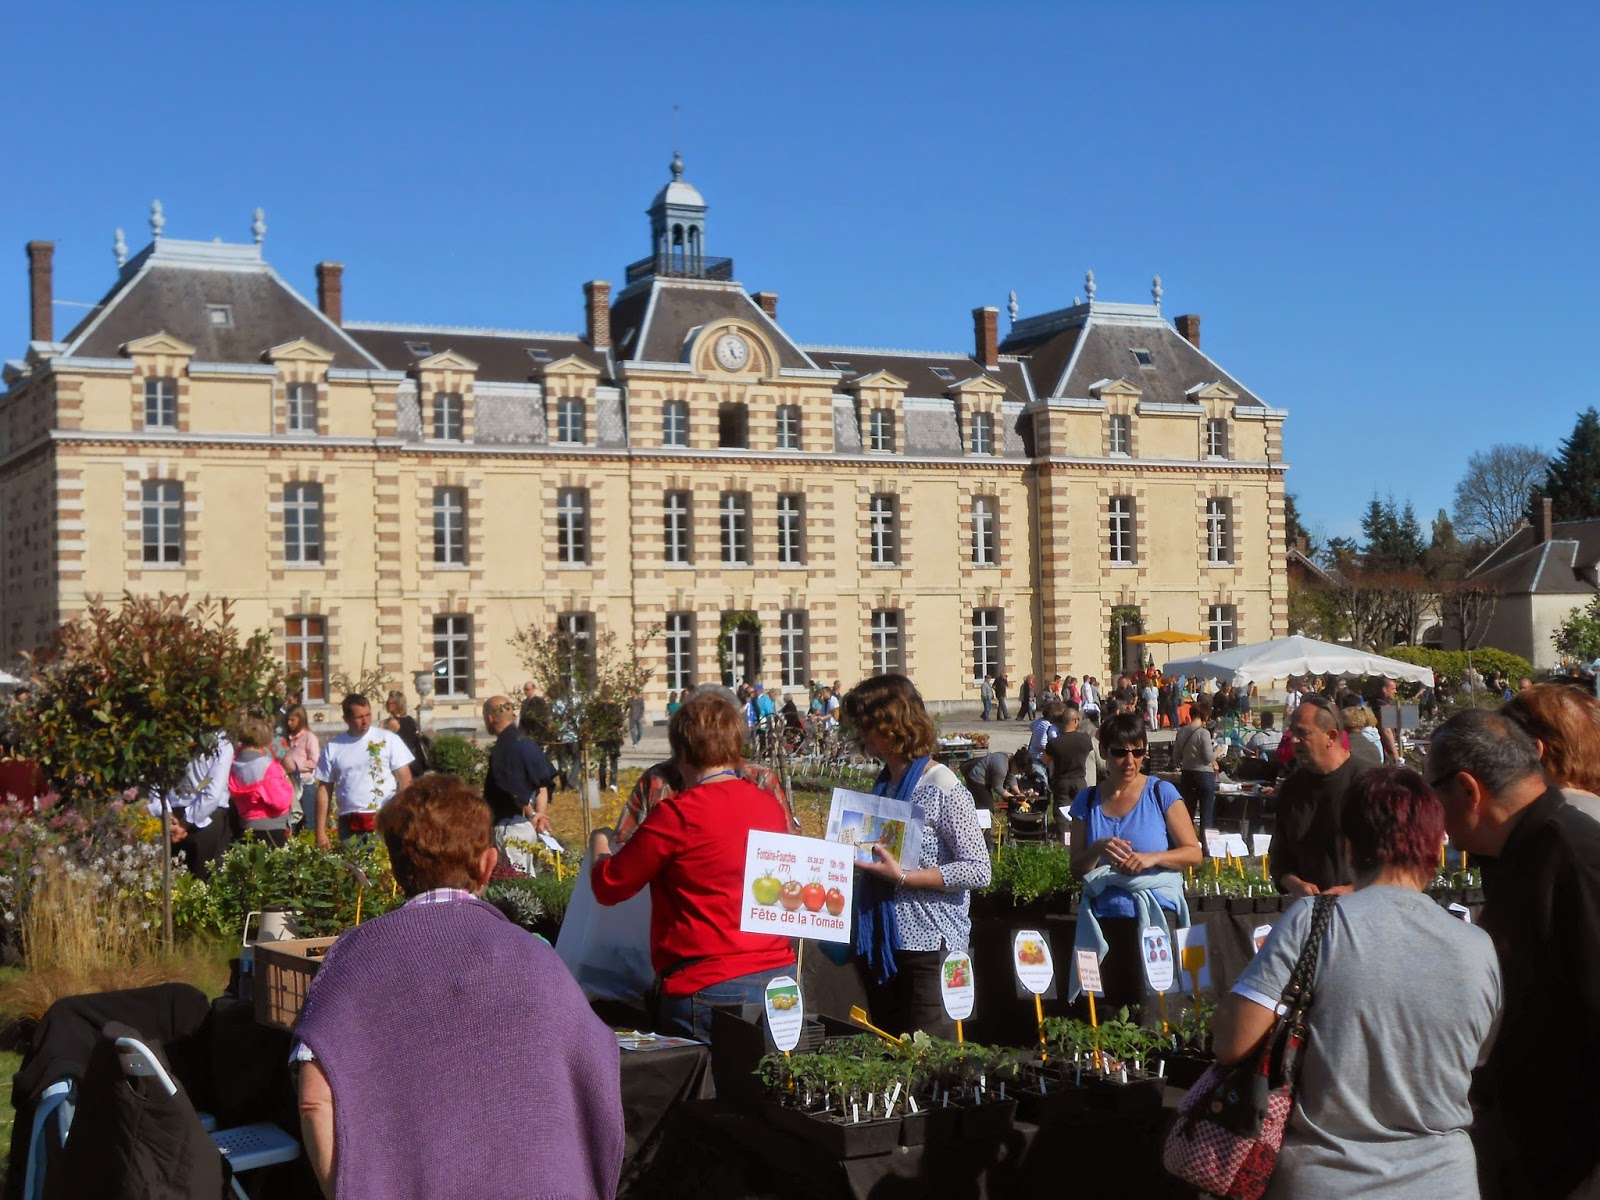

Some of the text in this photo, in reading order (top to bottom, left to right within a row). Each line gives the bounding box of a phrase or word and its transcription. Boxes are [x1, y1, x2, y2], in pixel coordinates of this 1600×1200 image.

[757, 848, 797, 863] Fontaine-Fourches
[778, 864, 791, 873] (77)
[750, 907, 845, 930] Fête de la Tomate
